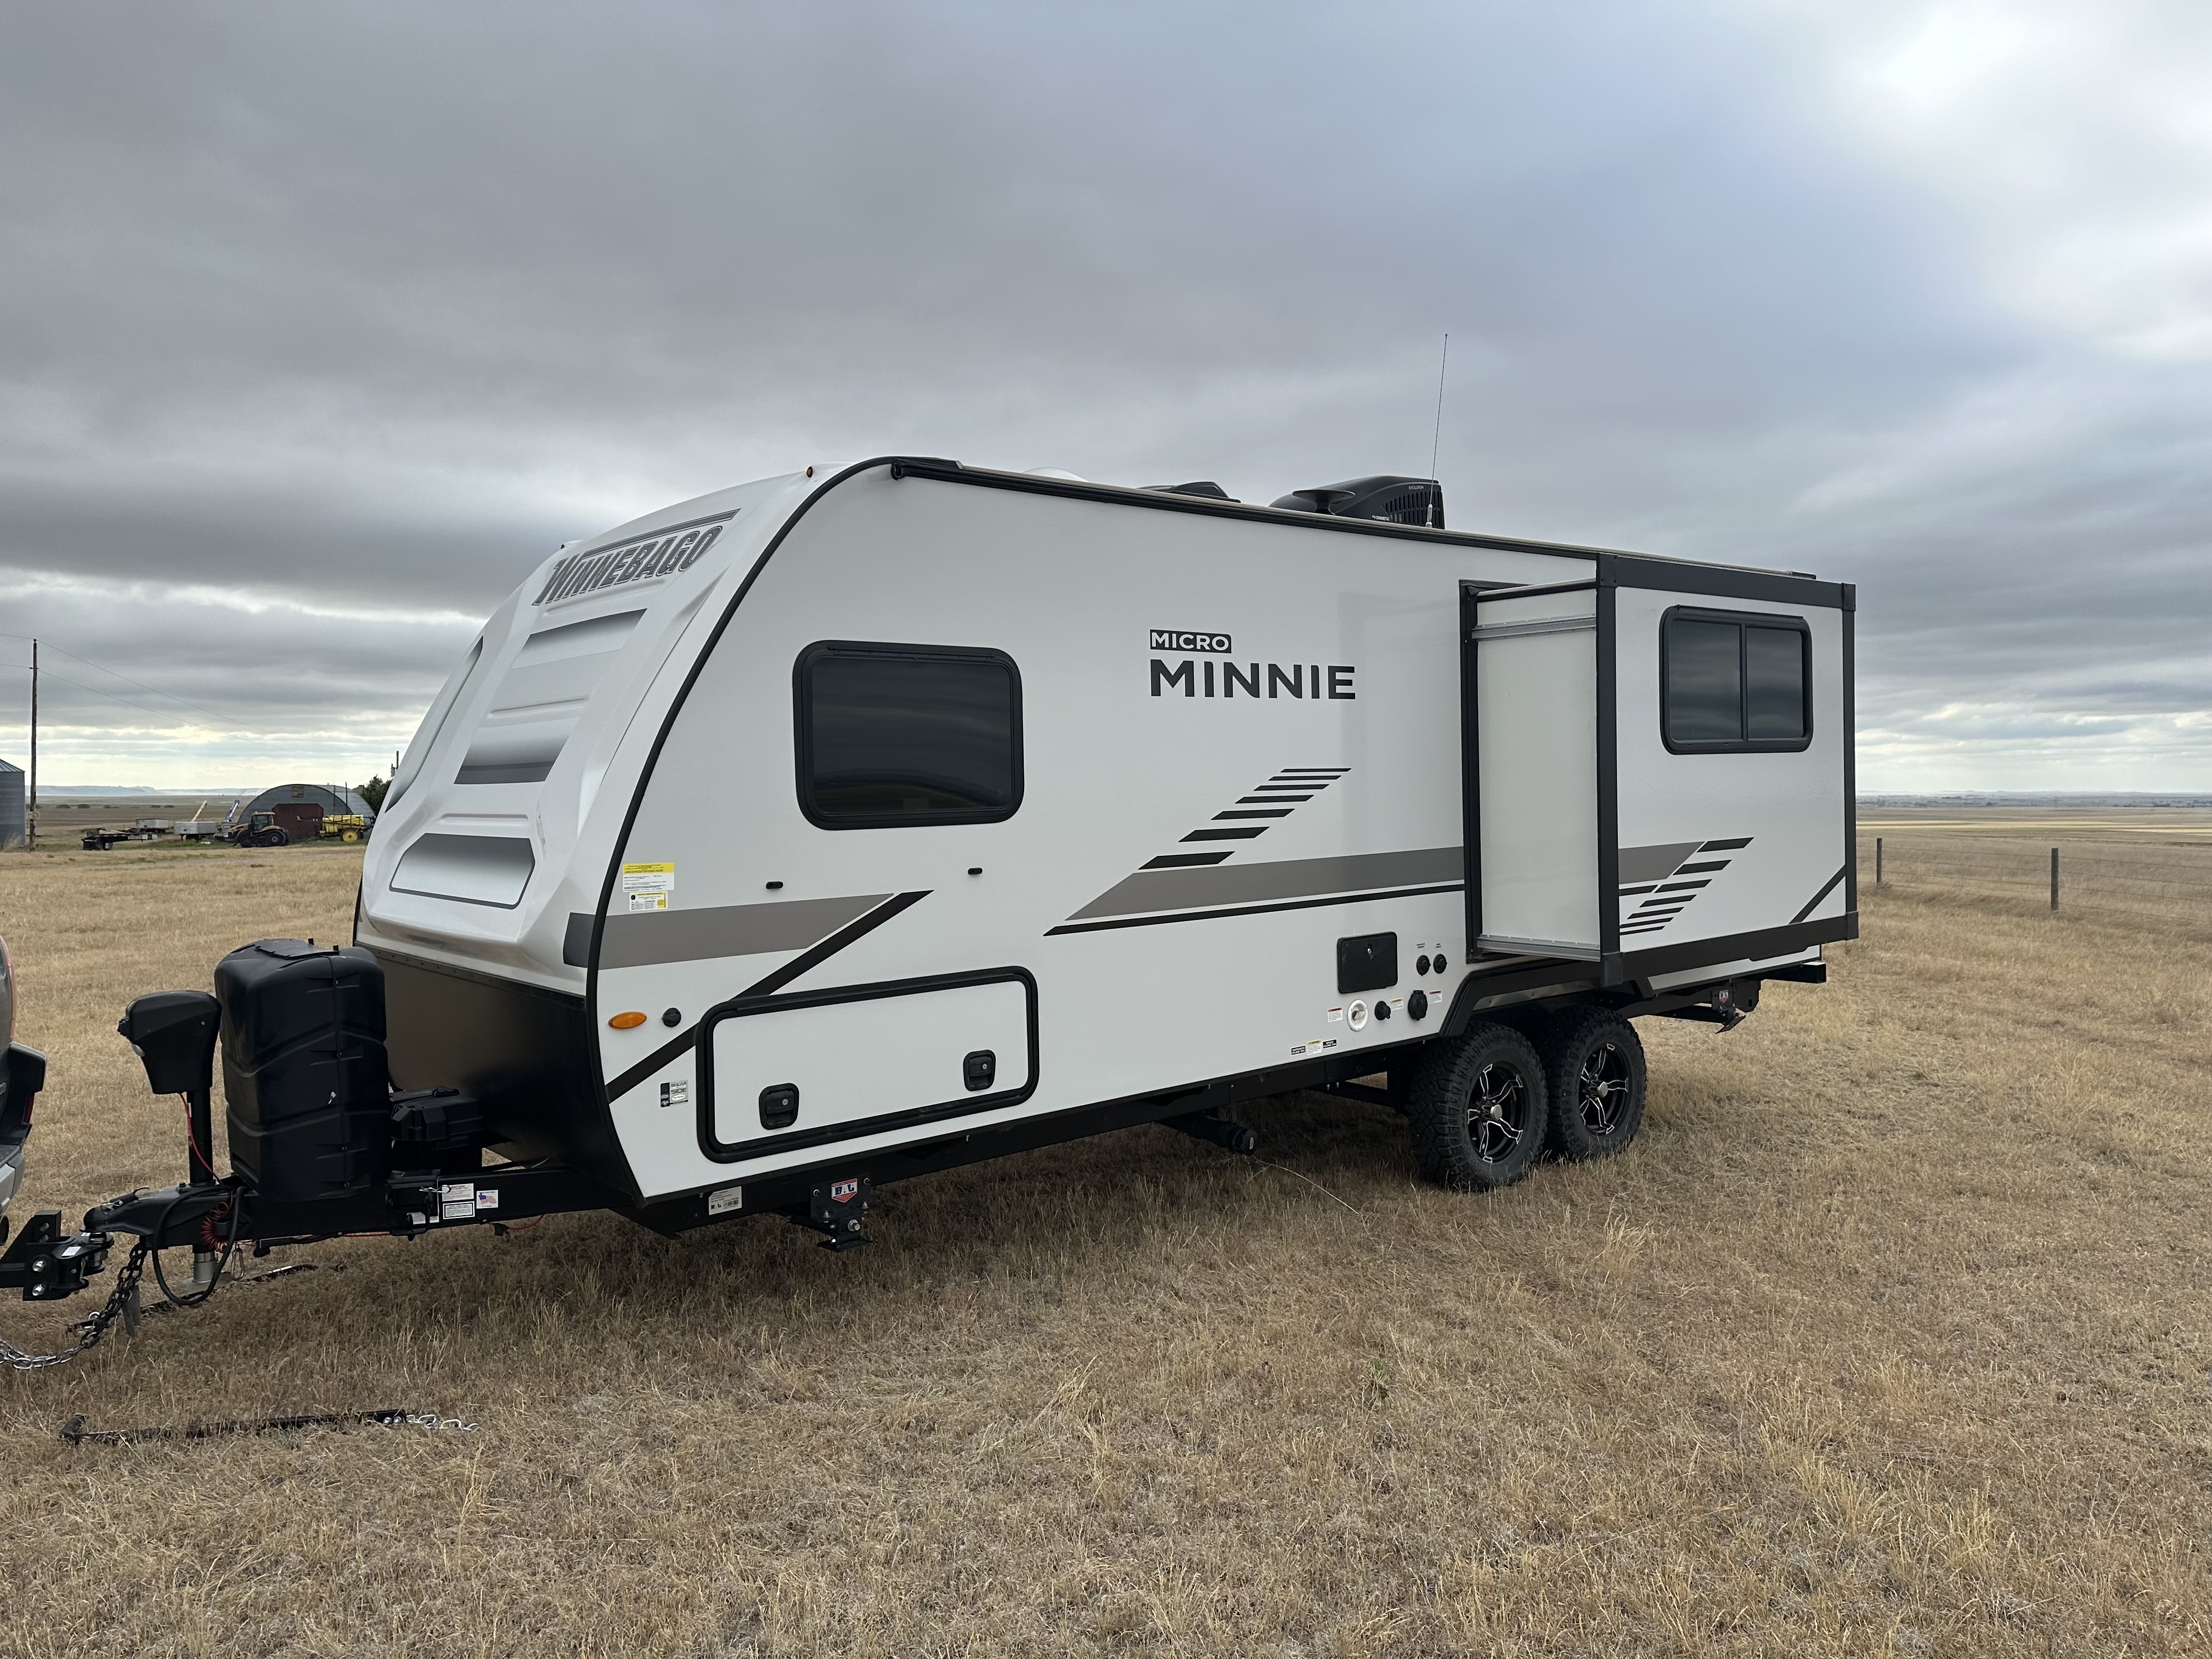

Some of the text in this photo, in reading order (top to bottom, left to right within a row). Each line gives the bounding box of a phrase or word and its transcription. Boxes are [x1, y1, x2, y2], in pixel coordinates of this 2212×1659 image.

[531, 526, 723, 606] WINNEBAGO
[1152, 631, 1229, 651] MICRO
[1150, 659, 1356, 699] MINNIE
[834, 1184, 855, 1195] BL
